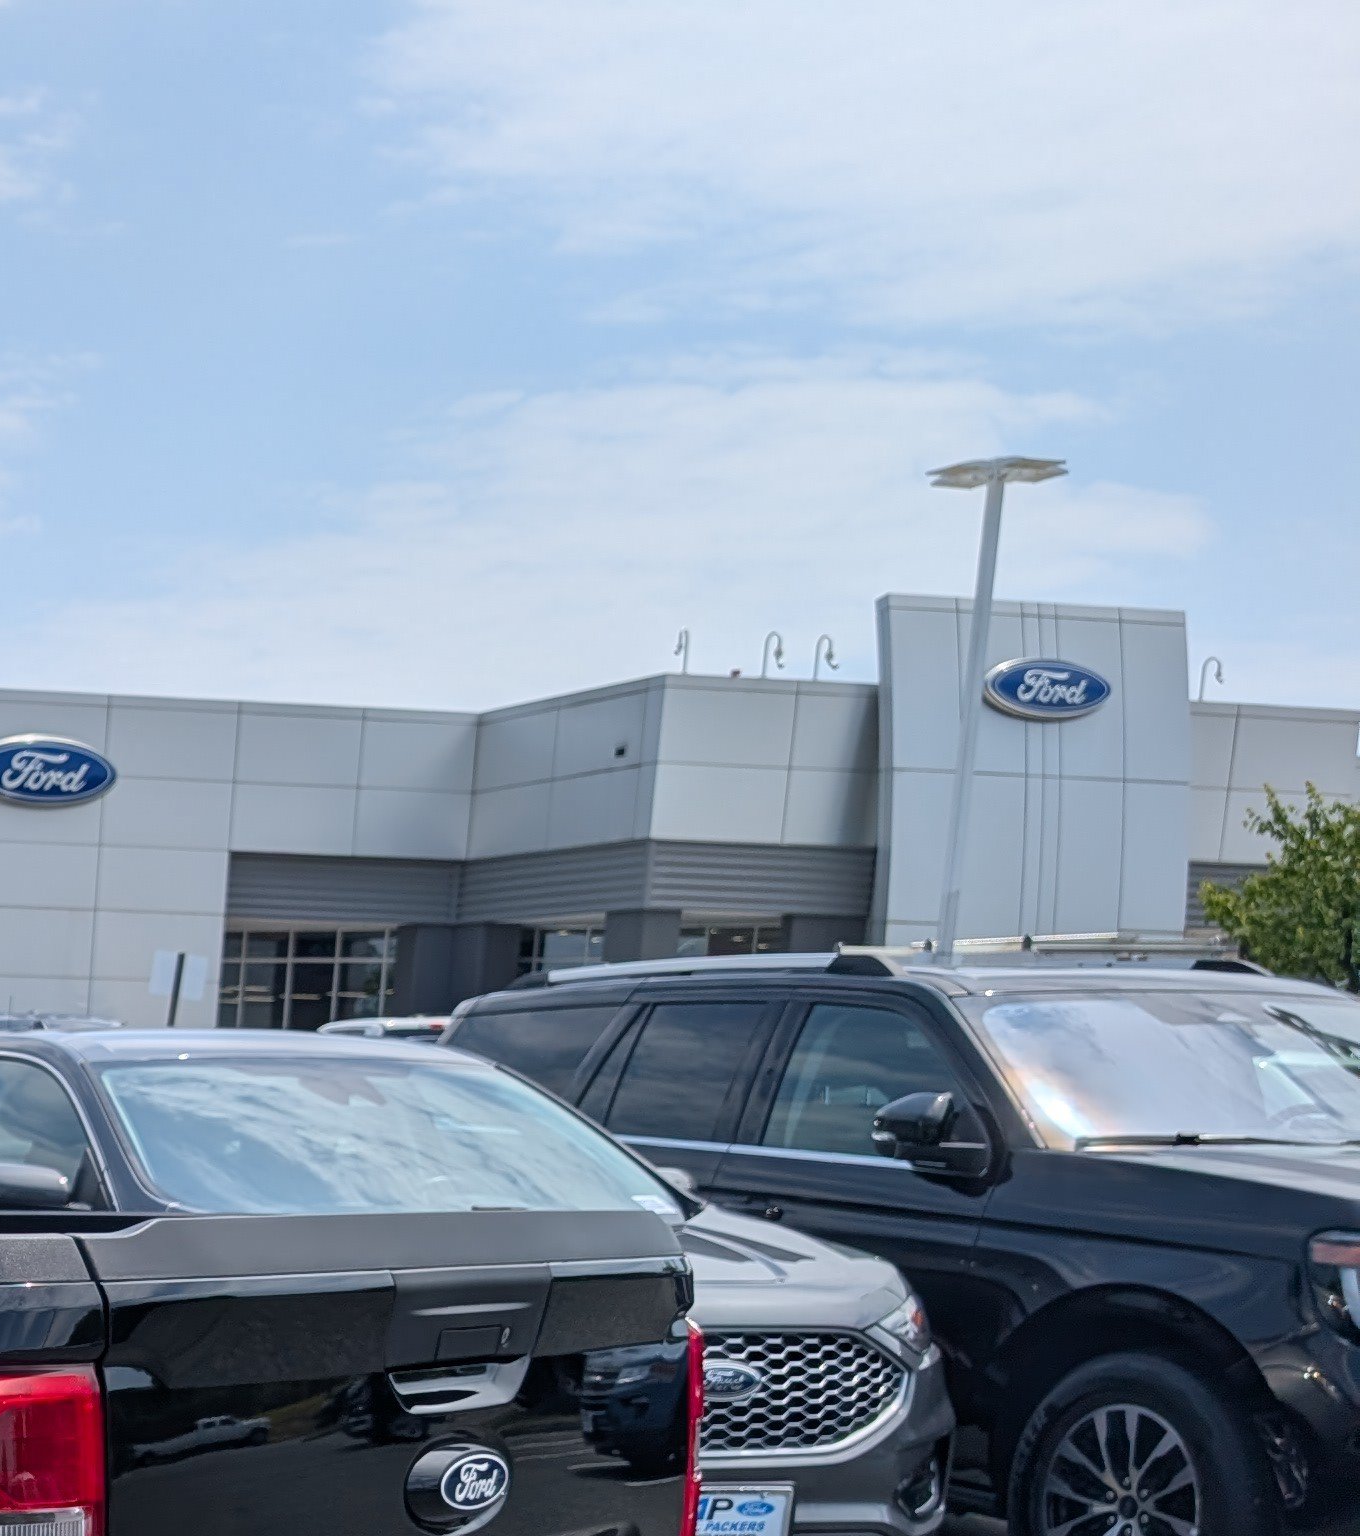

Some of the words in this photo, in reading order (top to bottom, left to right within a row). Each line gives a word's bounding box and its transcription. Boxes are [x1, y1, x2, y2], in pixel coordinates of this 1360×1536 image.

[1016, 668, 1088, 705] Ford
[0, 750, 91, 793] Ford
[455, 1462, 499, 1502] Ford
[705, 1521, 766, 1533] PACKERS
